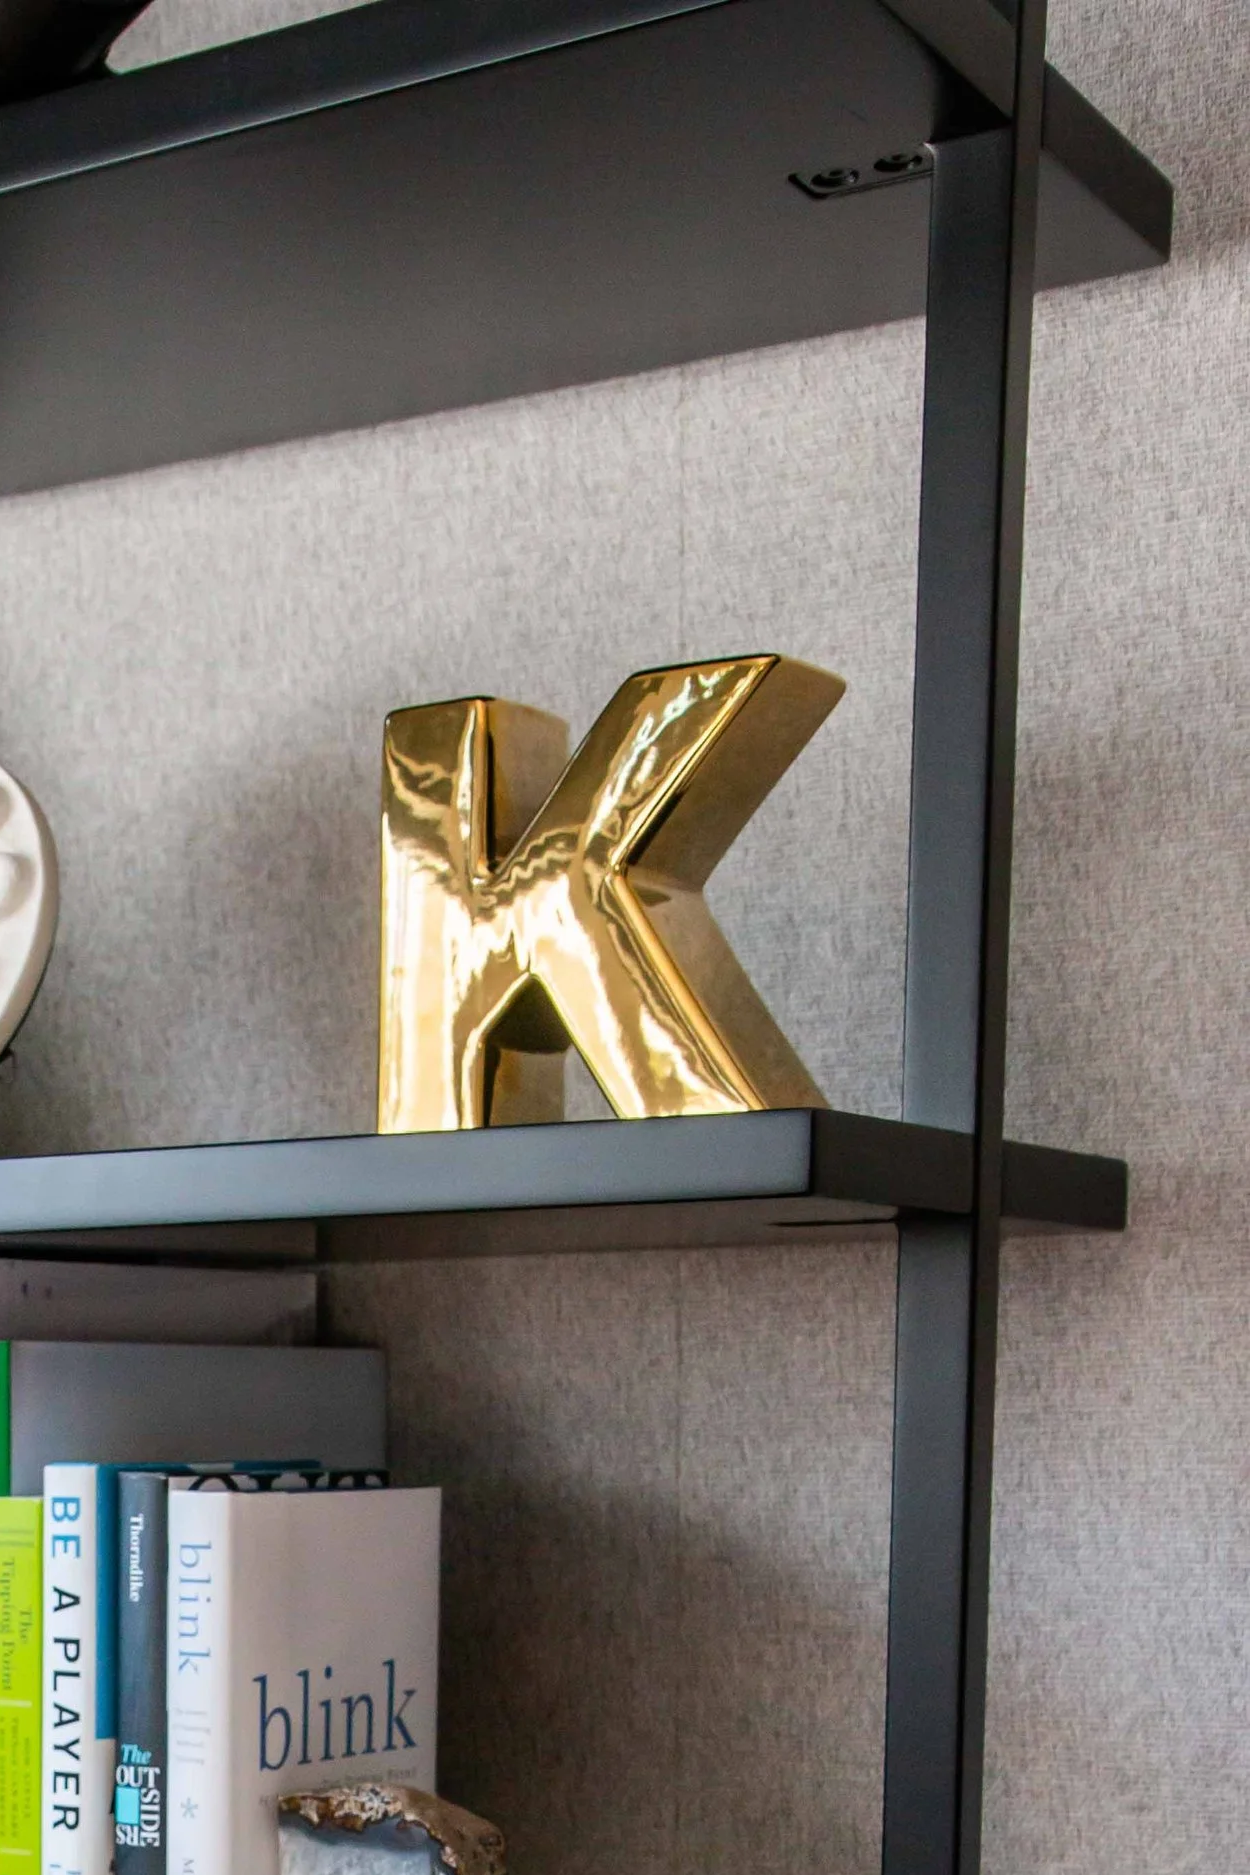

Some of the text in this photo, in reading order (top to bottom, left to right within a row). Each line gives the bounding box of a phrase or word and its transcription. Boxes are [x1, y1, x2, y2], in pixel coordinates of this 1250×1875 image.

[378, 653, 848, 1134] K
[129, 1513, 145, 1603] Thorndike
[177, 1541, 213, 1676] blink
[19, 1608, 34, 1645] The
[51, 1497, 81, 1831] BE A PLAYER
[120, 1743, 152, 1764] The
[252, 1659, 419, 1772] blink
